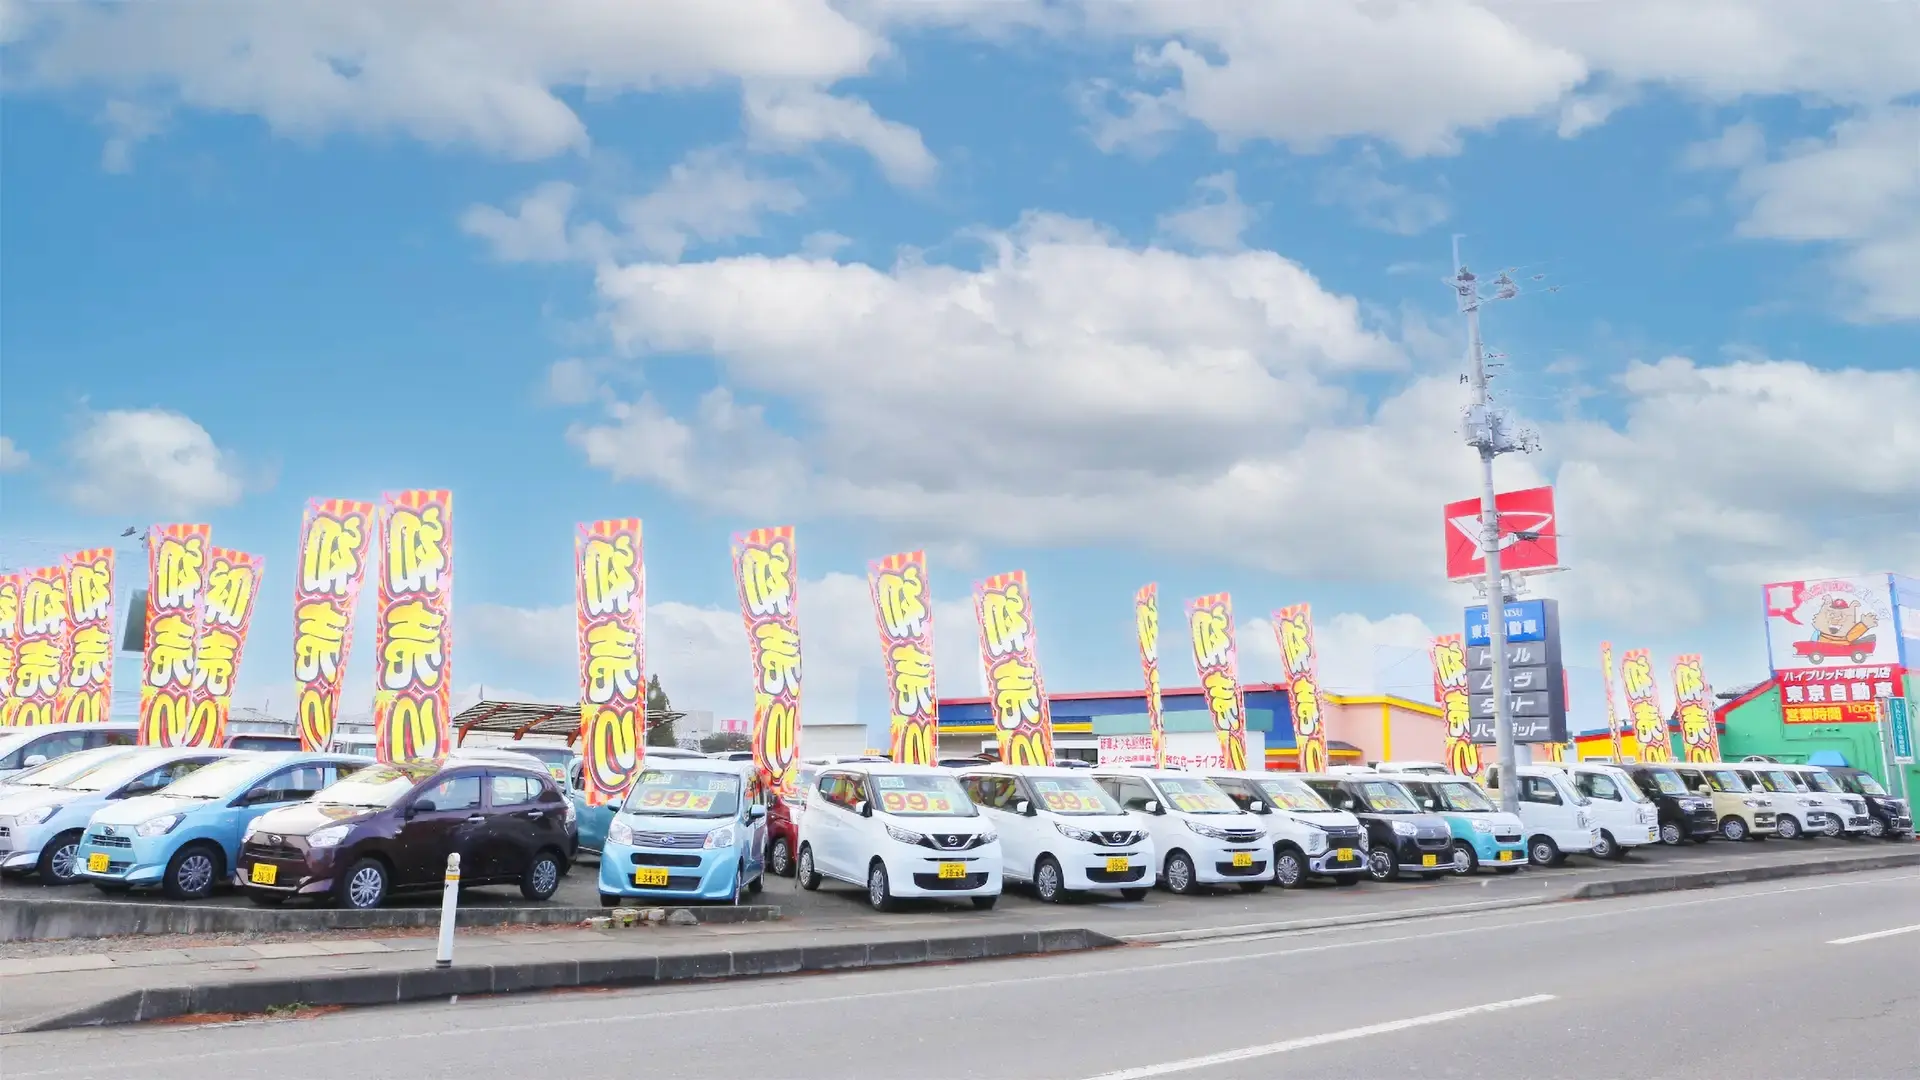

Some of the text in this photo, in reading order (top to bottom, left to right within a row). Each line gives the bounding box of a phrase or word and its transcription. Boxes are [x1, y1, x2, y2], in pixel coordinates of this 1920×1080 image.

[1480, 647, 1531, 666] トル
[1480, 672, 1533, 690] ムヴ
[1784, 667, 1891, 682] ハイブリッド車専門店
[1785, 682, 1895, 703] 東京自動車
[1481, 697, 1534, 713] タト
[1786, 706, 1843, 722] 営業時間
